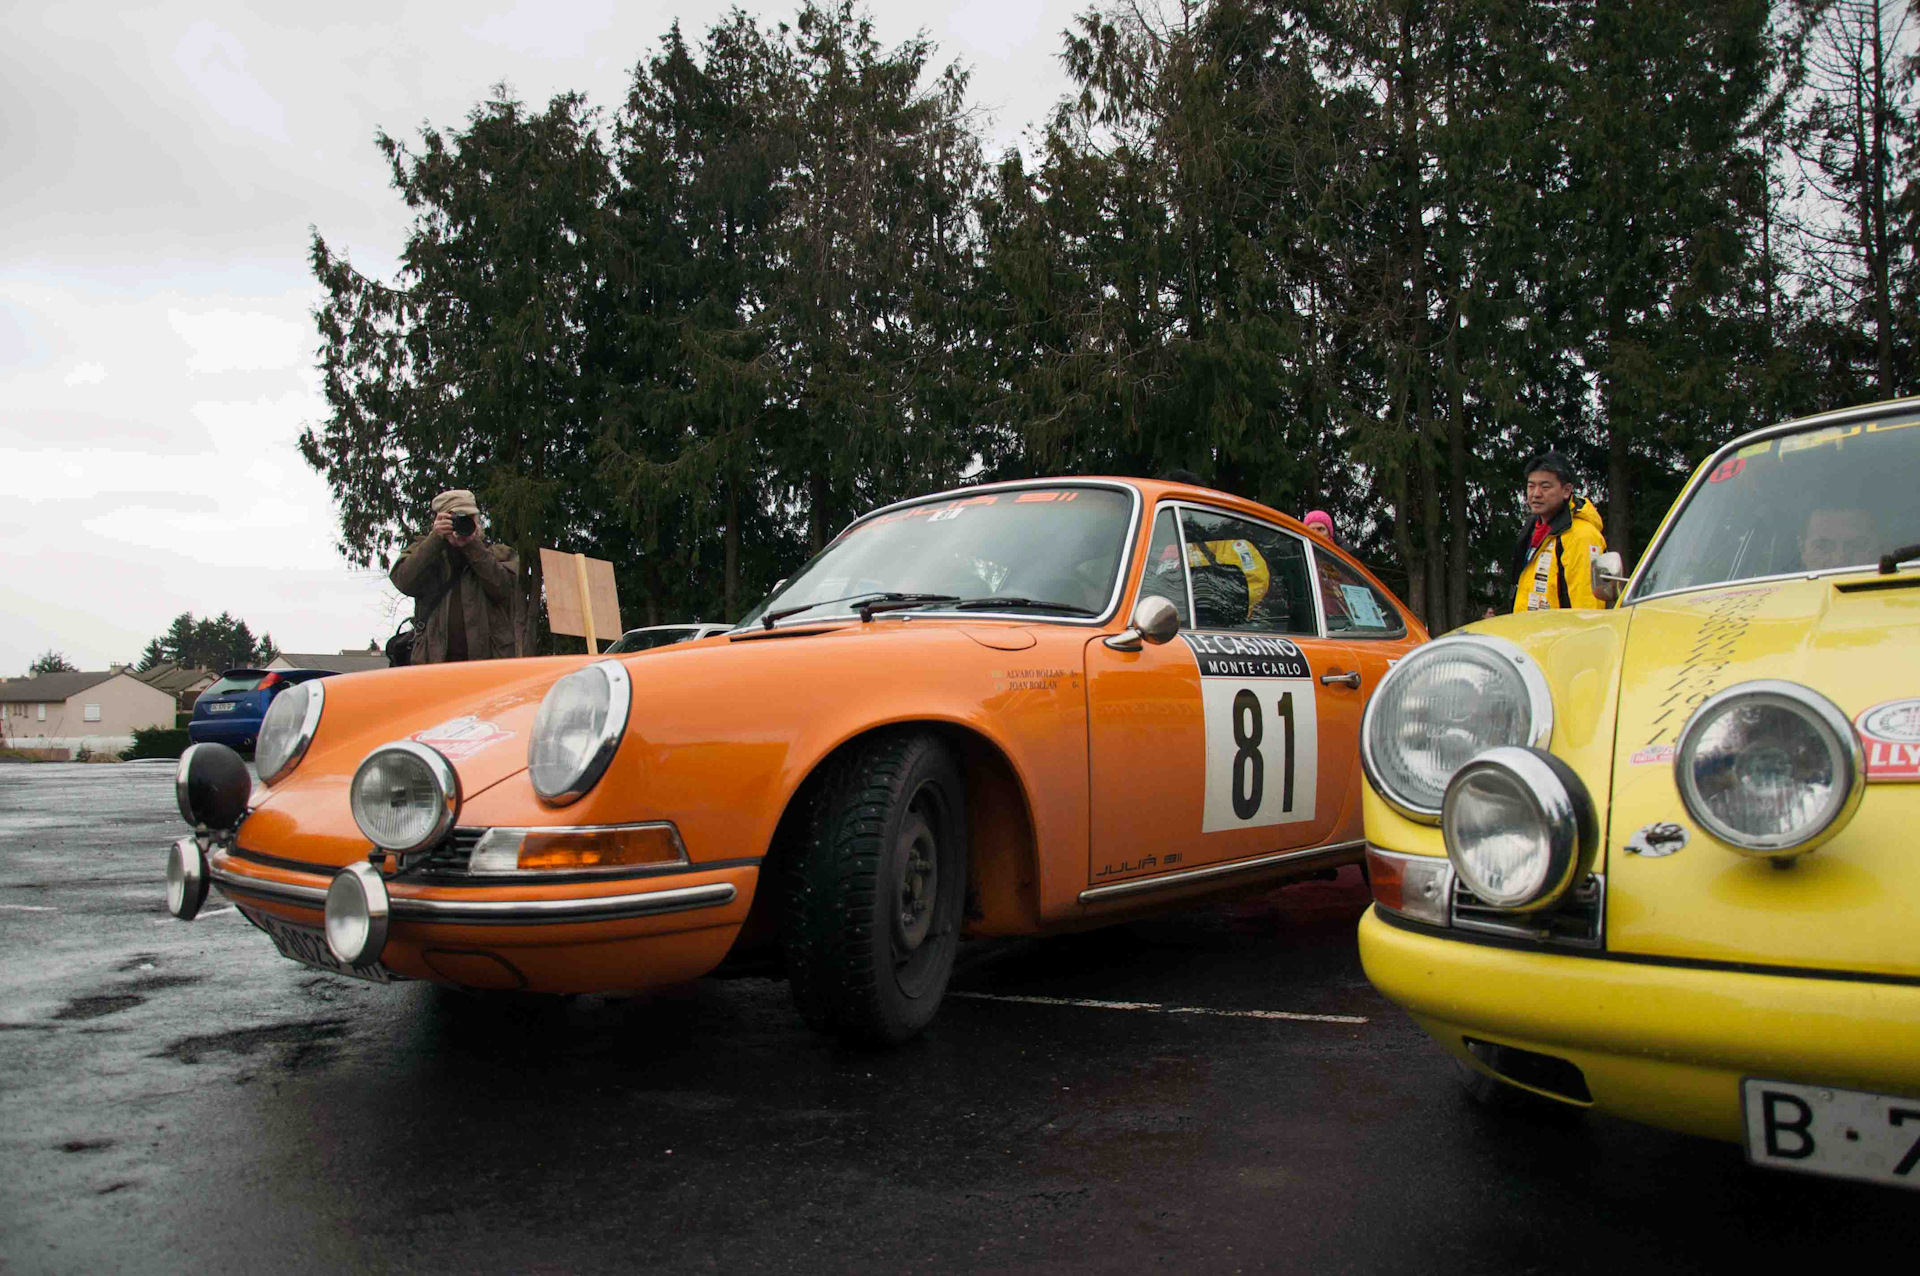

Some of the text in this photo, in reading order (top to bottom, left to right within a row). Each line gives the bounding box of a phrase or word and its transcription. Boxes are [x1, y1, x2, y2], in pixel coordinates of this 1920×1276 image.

[1184, 634, 1297, 657] LE CASINO
[1232, 688, 1294, 820] 81
